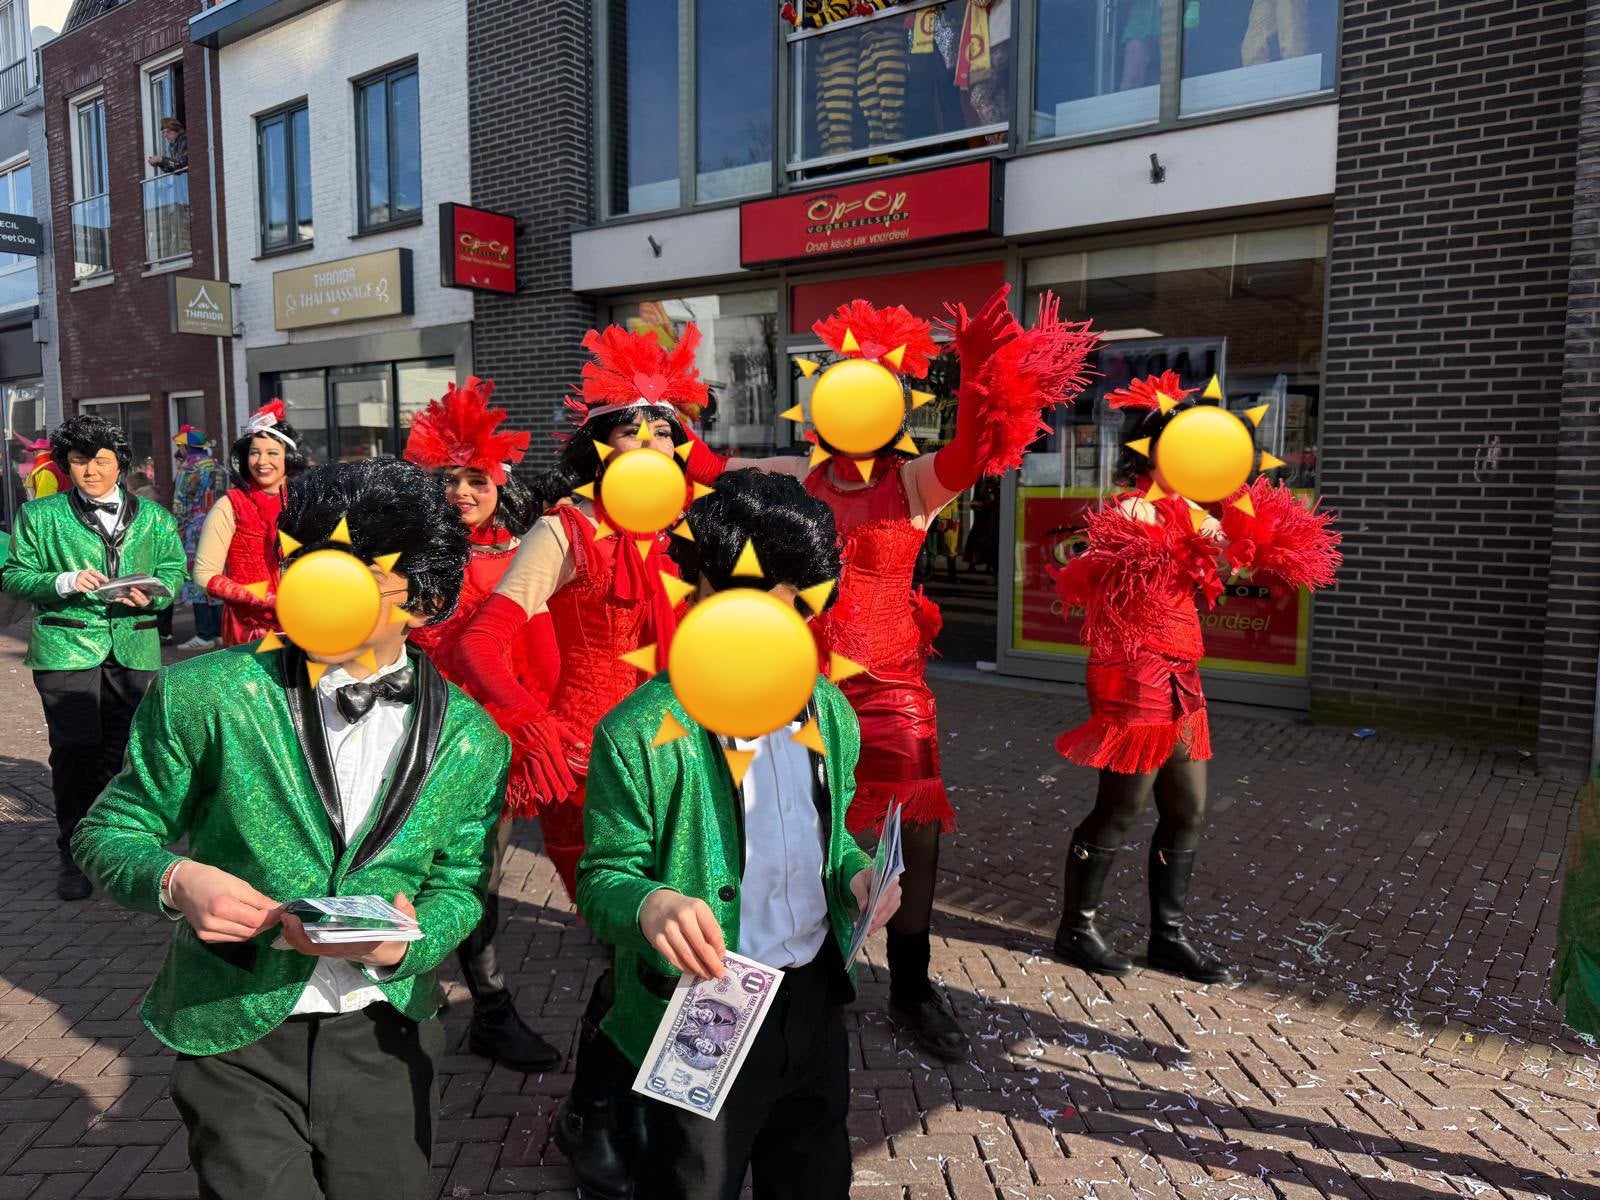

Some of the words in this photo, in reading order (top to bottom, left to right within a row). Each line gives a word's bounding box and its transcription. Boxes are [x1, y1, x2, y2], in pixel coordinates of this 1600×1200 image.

[807, 190, 907, 236] Op=Op
[807, 212, 910, 234] VOORDEELSHOP
[0, 220, 20, 230] ECIL
[806, 241, 829, 253] Onze
[830, 239, 852, 249] keus
[869, 227, 910, 243] voordeel
[313, 266, 356, 289] THANIDA
[300, 290, 323, 307] THAI
[325, 282, 374, 304] MASSAGE
[184, 308, 225, 322] THANIDA
[1198, 613, 1271, 632] oordeel
